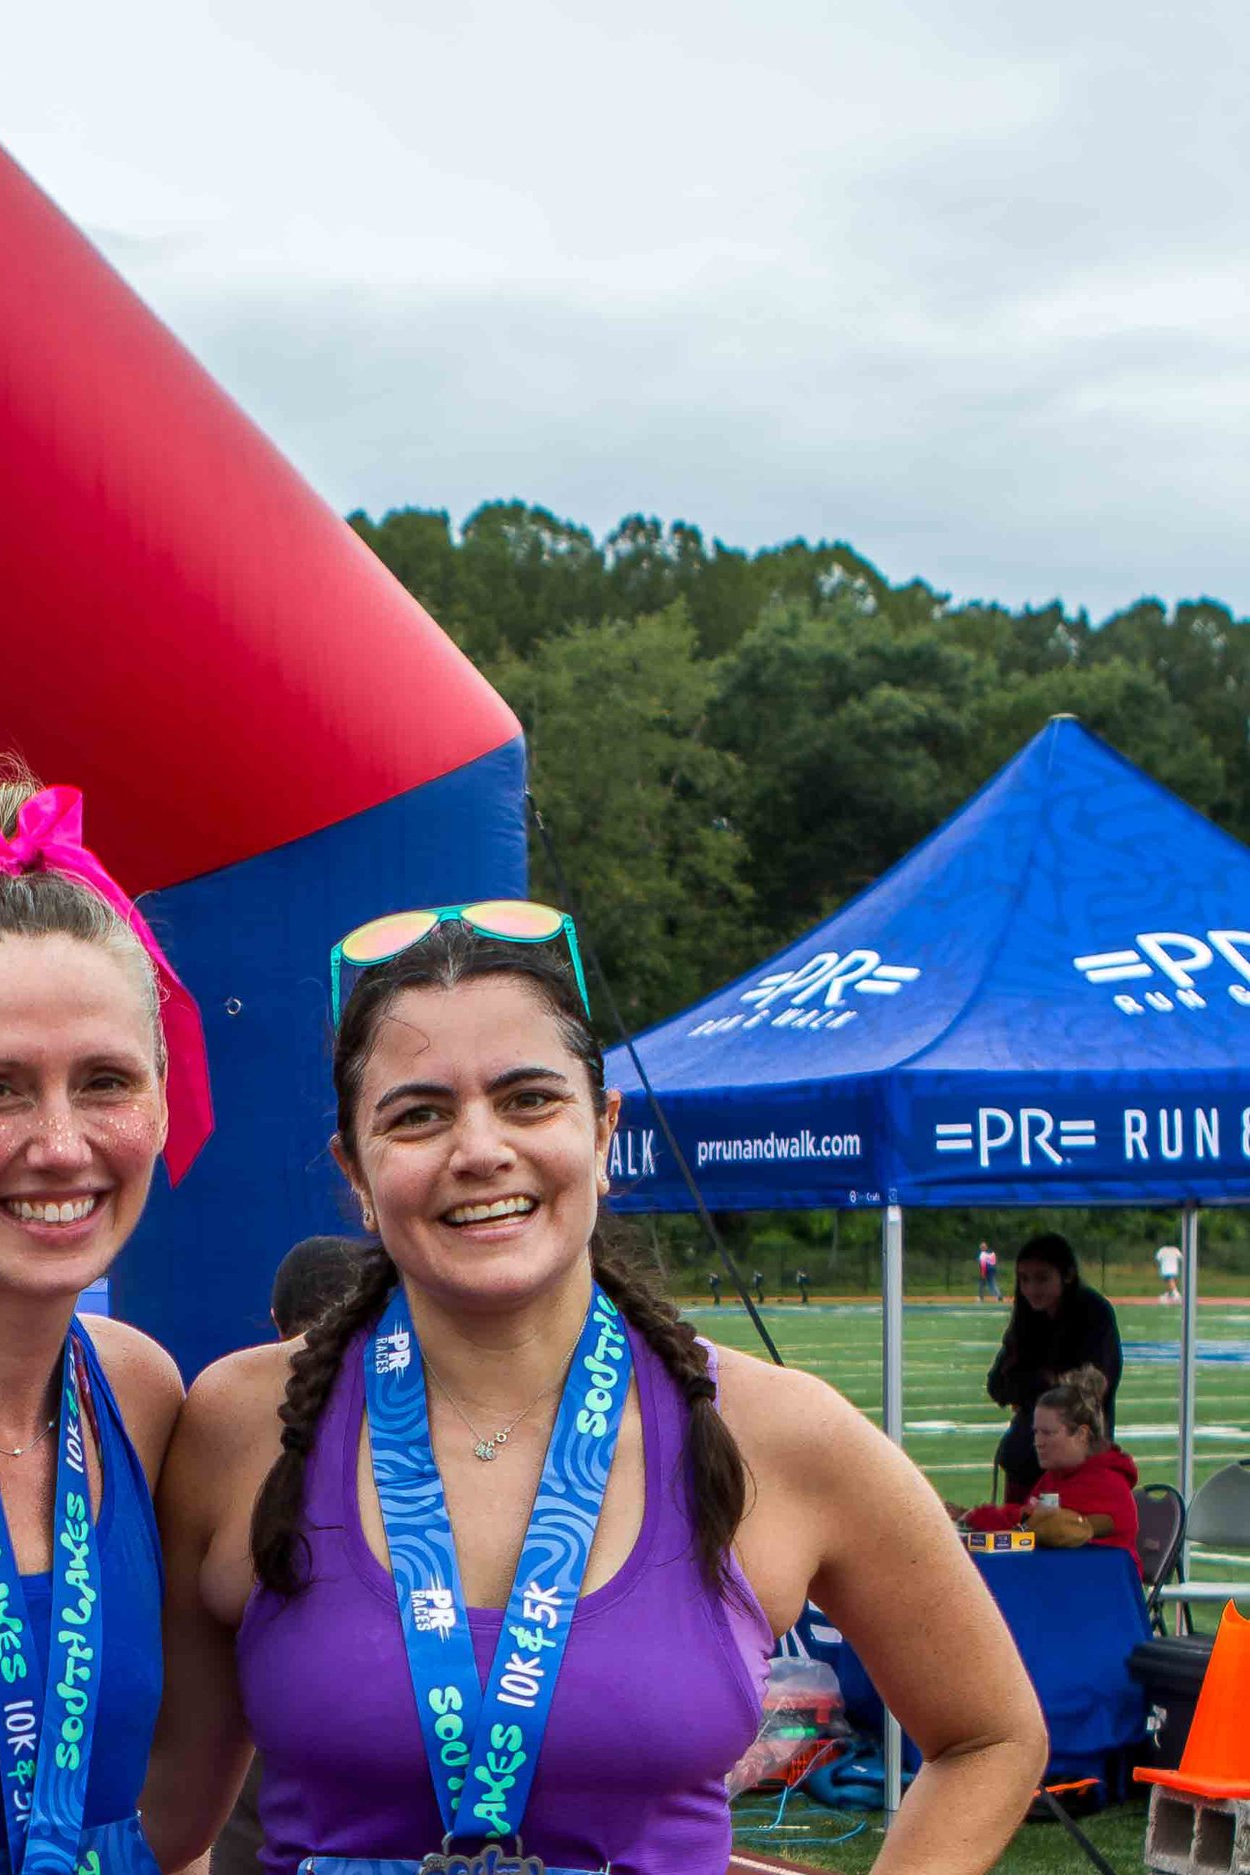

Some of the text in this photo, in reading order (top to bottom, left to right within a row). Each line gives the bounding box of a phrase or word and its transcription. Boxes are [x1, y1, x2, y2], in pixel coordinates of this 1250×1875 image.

[1113, 988, 1207, 1016] RUN
[611, 1129, 861, 1176] ALK prrunandwalk.com
[1124, 1107, 1220, 1160] RUN
[375, 1337, 389, 1374] RACES
[388, 1332, 410, 1371] PR
[576, 1310, 625, 1438] SOUTH
[66, 1418, 84, 1474] 10K
[60, 1491, 97, 1625] LAKES
[410, 1591, 431, 1631] RACES
[426, 1589, 456, 1630] PR
[55, 1630, 94, 1771] SOUTH
[473, 1581, 562, 1838] AKES 10K & 5K
[4, 1700, 37, 1756] 10K
[428, 1686, 471, 1811] SOU
